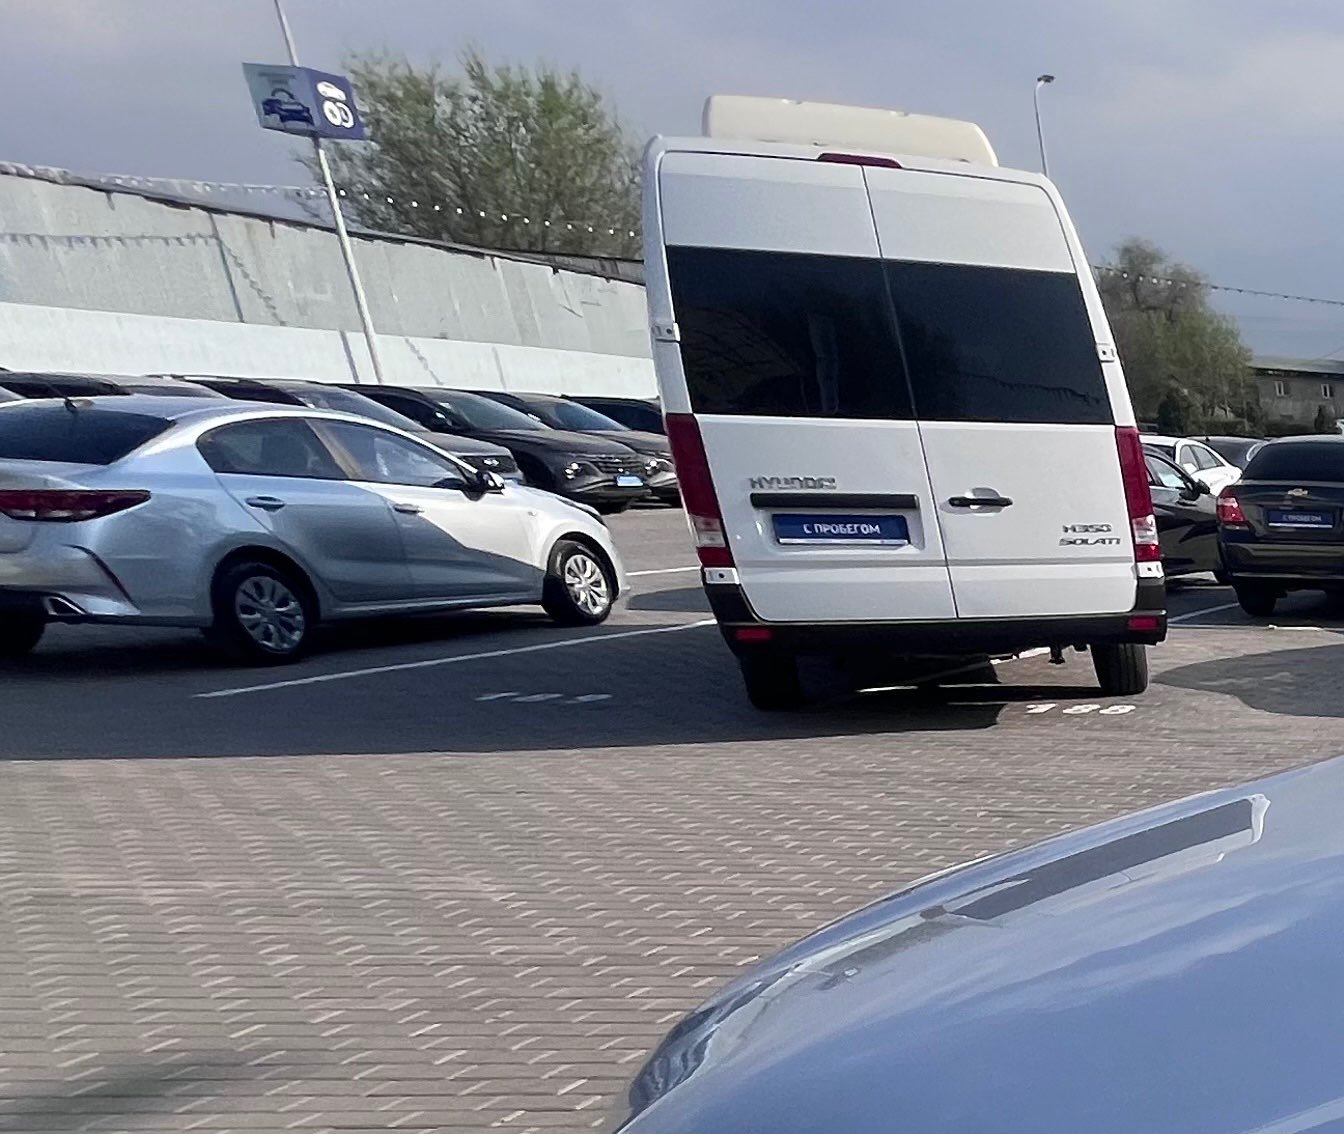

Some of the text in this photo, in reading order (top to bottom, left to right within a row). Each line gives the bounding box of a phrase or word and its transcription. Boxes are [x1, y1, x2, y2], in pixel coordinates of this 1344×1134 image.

[749, 477, 837, 490] HYUNDAI
[803, 523, 881, 535] С ПРОБЕГОМ
